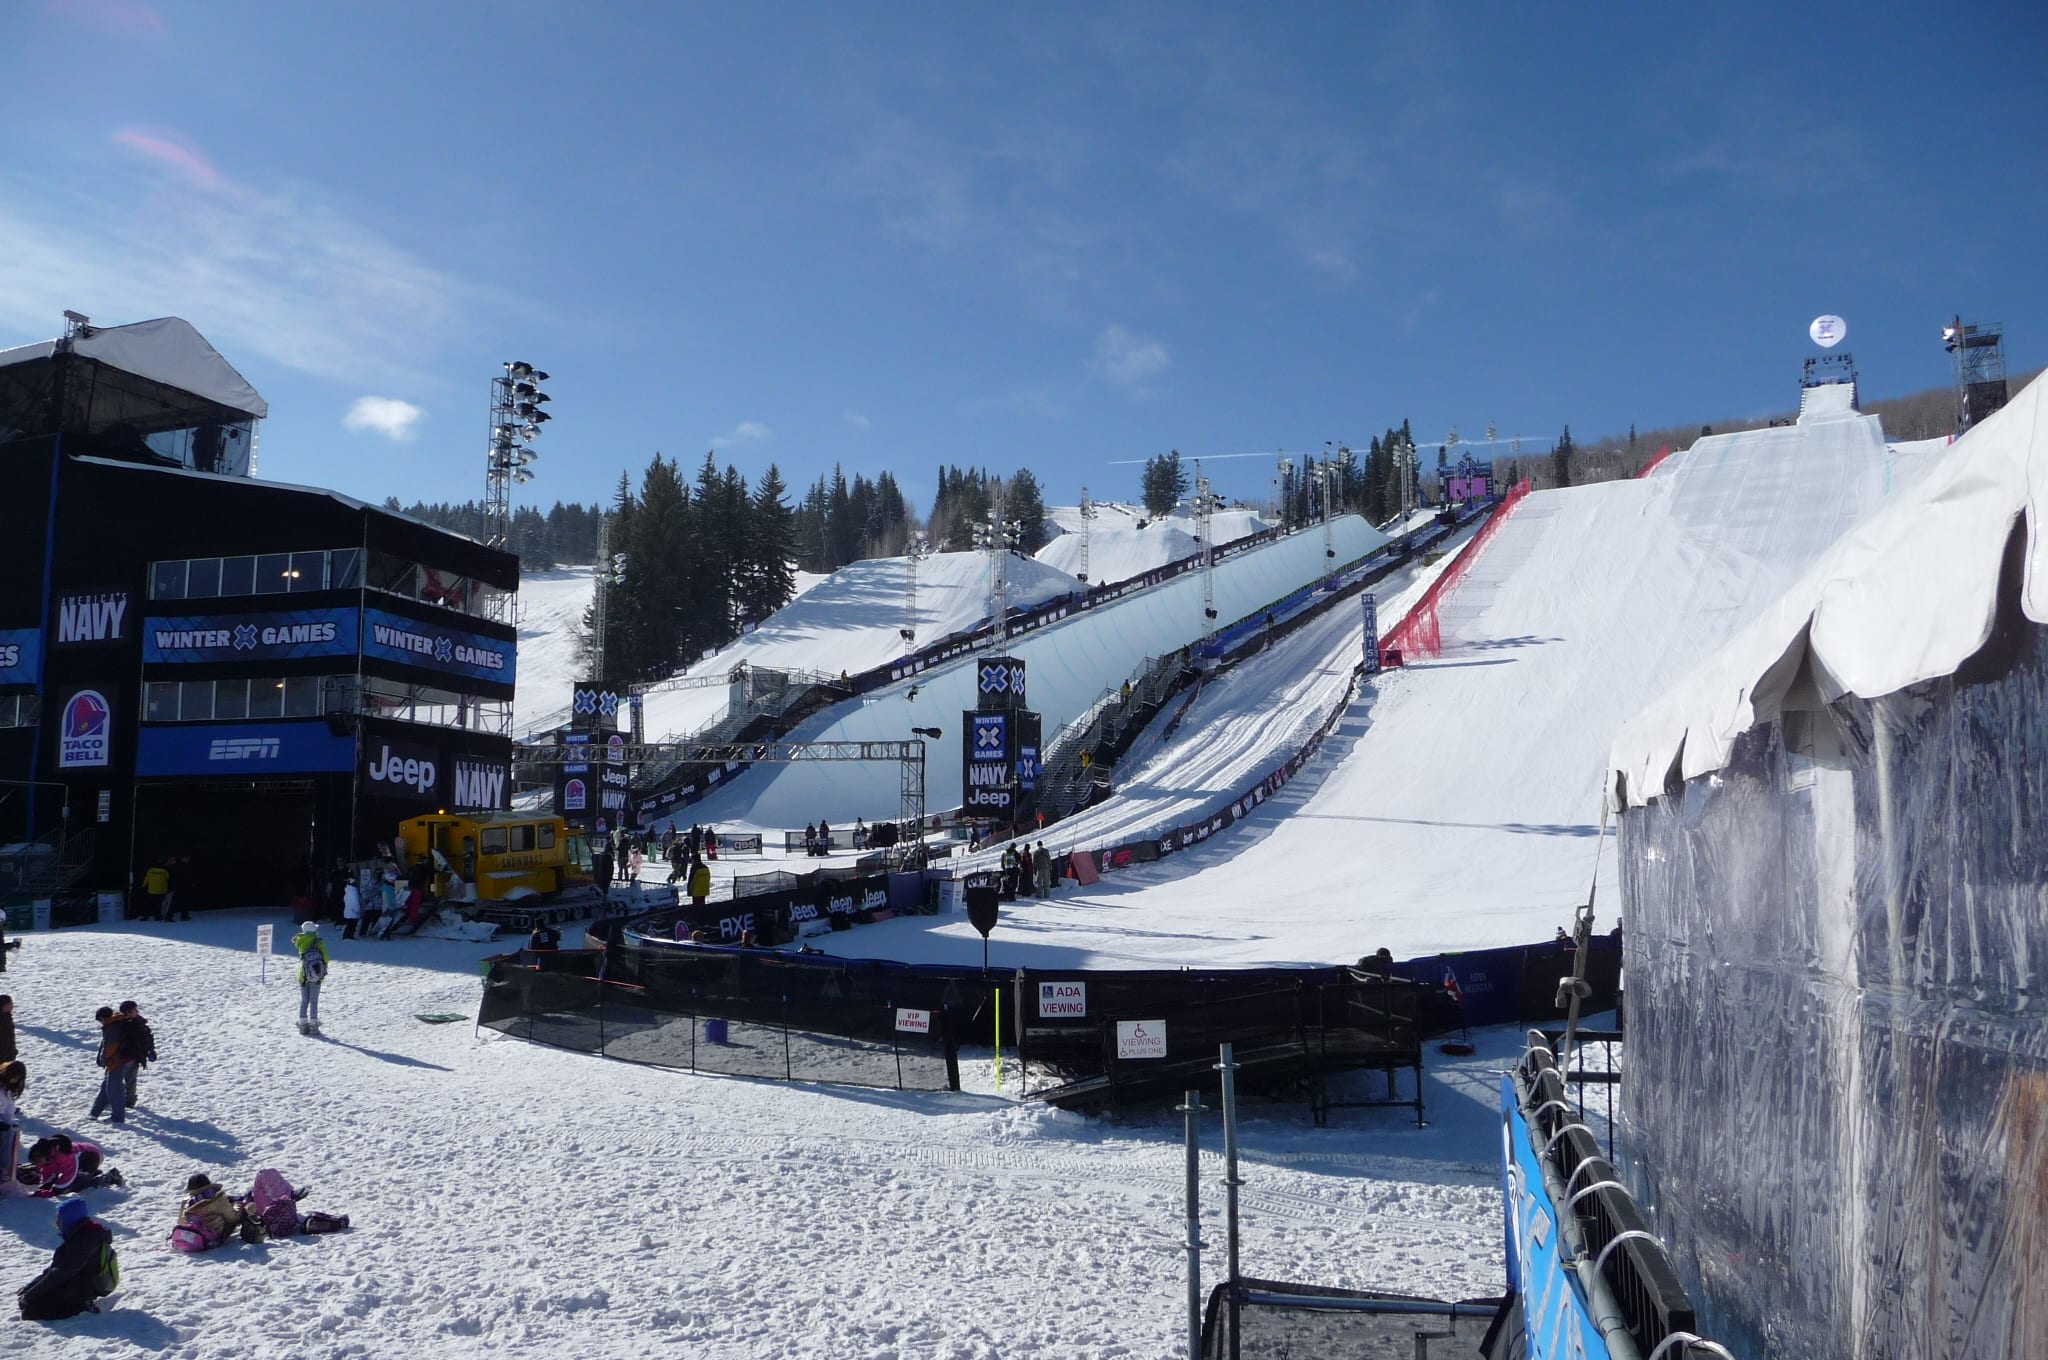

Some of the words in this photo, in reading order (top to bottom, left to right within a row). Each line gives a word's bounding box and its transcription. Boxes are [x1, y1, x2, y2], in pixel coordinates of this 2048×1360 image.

[58, 600, 127, 642] NAVY
[156, 630, 230, 648] WINTER
[262, 622, 336, 646] GAMES
[1366, 610, 1375, 667] FINISH
[374, 624, 432, 655] WINTER
[455, 645, 503, 669] GAMES
[64, 739, 104, 750] TACO
[209, 738, 280, 760] ESPN
[974, 750, 1003, 758] GAMES
[64, 751, 104, 761] BELL
[369, 746, 436, 793] Jeep
[602, 768, 627, 787] Jeep
[970, 766, 1007, 786] NAVY
[455, 770, 504, 809] NAVY
[661, 793, 676, 803] Jeep
[968, 788, 1010, 808] Jeep
[602, 790, 626, 809] NAVY
[641, 800, 656, 810] Jeep
[826, 896, 852, 915] Jeep
[862, 888, 888, 909] Jeep
[788, 902, 817, 922] Jeep
[720, 912, 754, 938] AXE
[1056, 986, 1081, 996] ADA
[1042, 1002, 1083, 1013] VIEWING
[898, 1018, 928, 1029] VIEWING
[1122, 1037, 1161, 1046] VIEWING
